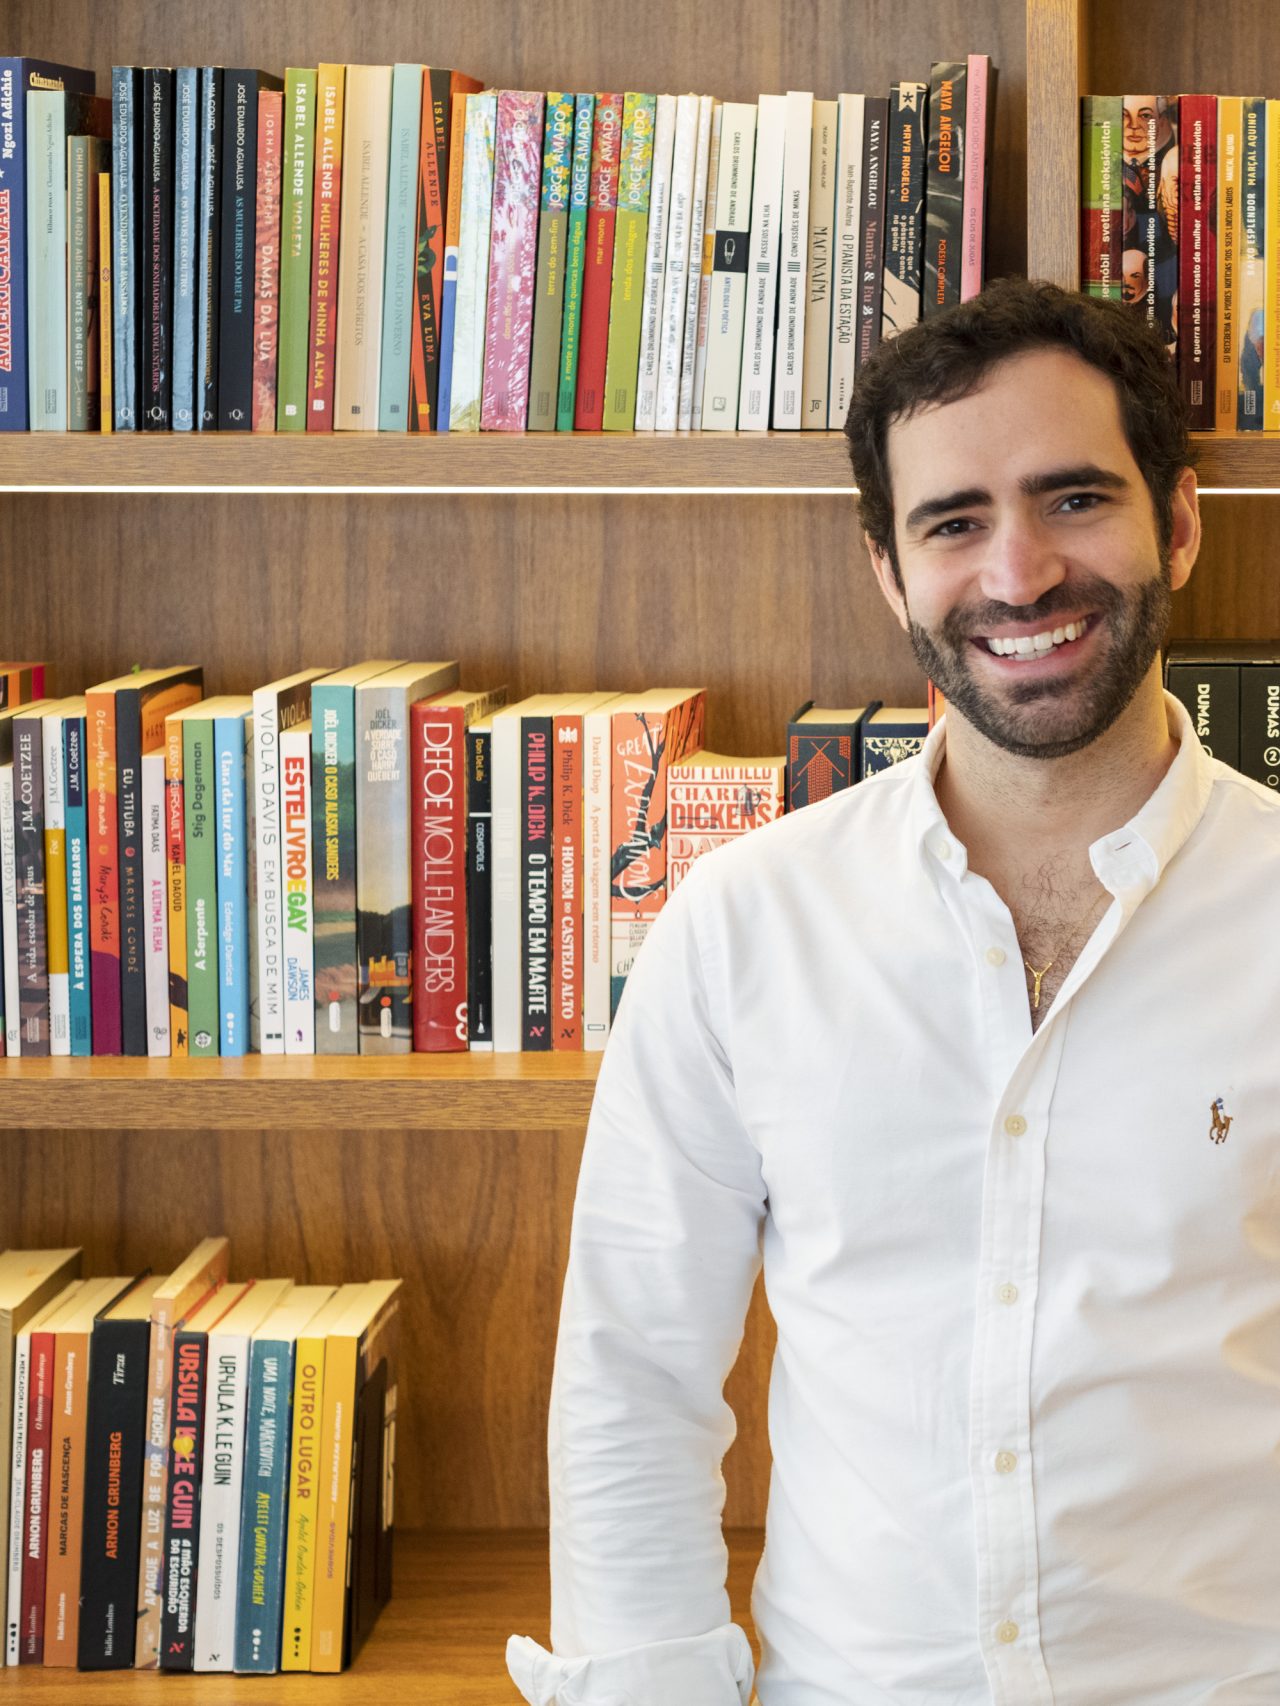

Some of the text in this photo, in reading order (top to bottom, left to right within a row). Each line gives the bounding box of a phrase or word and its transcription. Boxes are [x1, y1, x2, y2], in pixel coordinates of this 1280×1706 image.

[2, 71, 16, 158] Ngozi Adichie
[938, 81, 953, 172] MAYA ANGELOU
[292, 83, 306, 257] ISABEL ALLENDE VIOLETA
[549, 111, 566, 207] JORGE AMADO
[1193, 121, 1202, 210] svetlana aleksiévitch
[75, 148, 83, 288] CHIMAMANDA NGOZI ADICHIE
[314, 86, 335, 388] ISABEL ALLENDE MULHERES DE MINHA ALMA
[547, 219, 558, 295] terras do sem-fim
[841, 243, 853, 284] PIANISTA
[841, 288, 851, 300] DA
[937, 240, 947, 305] POESIA COMPLETA
[75, 326, 82, 340] ON
[260, 246, 273, 360] DAMAS DA LUA
[422, 294, 434, 362] EVA LUNA
[837, 303, 853, 343] ESTAÇÃO
[75, 344, 83, 371] GRIEF
[1198, 684, 1210, 736] DUMAS
[1267, 686, 1279, 737] DUMAS
[20, 734, 35, 832] J.M. COETZEE
[260, 710, 276, 846] VIOLA DAVIS
[528, 733, 546, 840] PHILIP K. DICK
[670, 787, 772, 801] CHARLES
[670, 803, 772, 830] DICKENS
[424, 723, 454, 992] DEFOE MOLL FLANDERS
[562, 846, 574, 898] HOMEM
[70, 838, 84, 990] À ESPERA DOS BÁRBAROS
[528, 854, 546, 1015] O TEMPO EM MARTE
[562, 917, 574, 979] CASTELO
[287, 957, 298, 1001] DAWSON
[298, 967, 309, 1000] JAMES
[562, 982, 574, 1018] ALTO
[113, 1354, 125, 1384] Tirza
[214, 1356, 236, 1485] URSULA K. LE GUIN
[296, 1365, 317, 1498] OUTRO LUGAR
[106, 1432, 122, 1559] ARNON GRUNBERG
